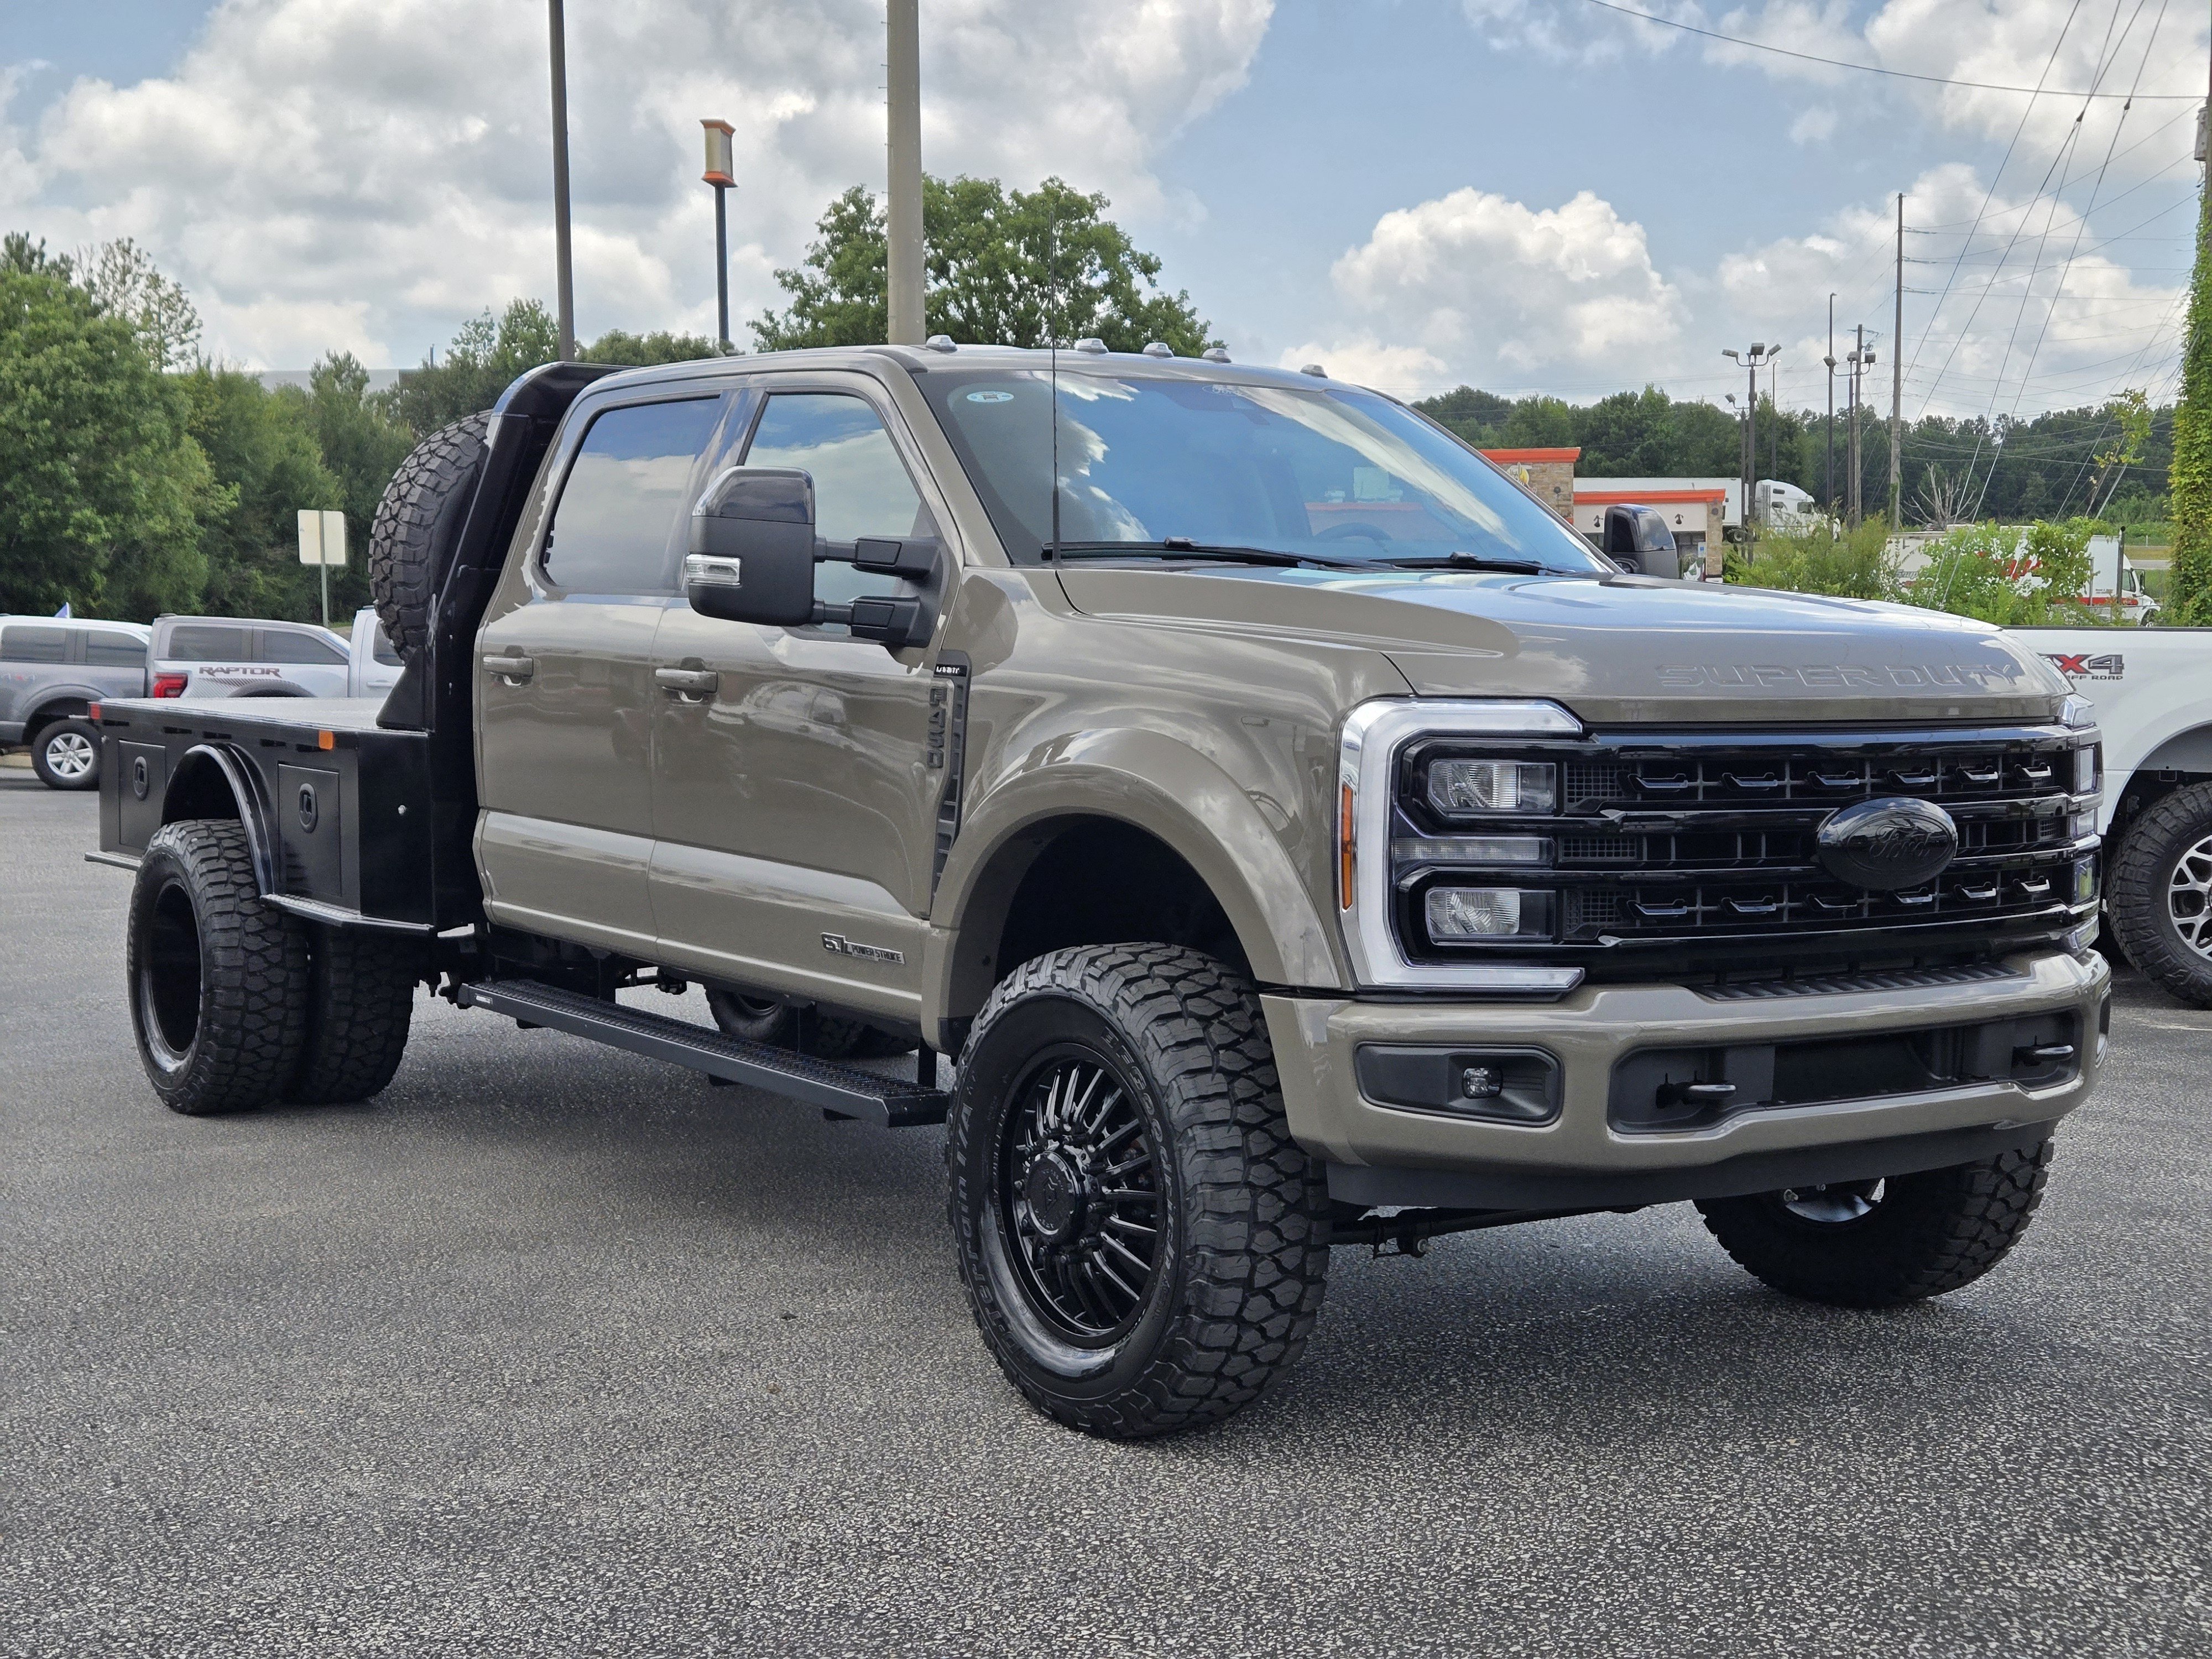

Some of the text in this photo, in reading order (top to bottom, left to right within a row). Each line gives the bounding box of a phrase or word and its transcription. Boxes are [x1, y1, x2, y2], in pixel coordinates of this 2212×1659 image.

[199, 666, 283, 679] RAPTOR
[2036, 653, 2125, 675] X4
[1656, 664, 2017, 687] SUPER DUTY
